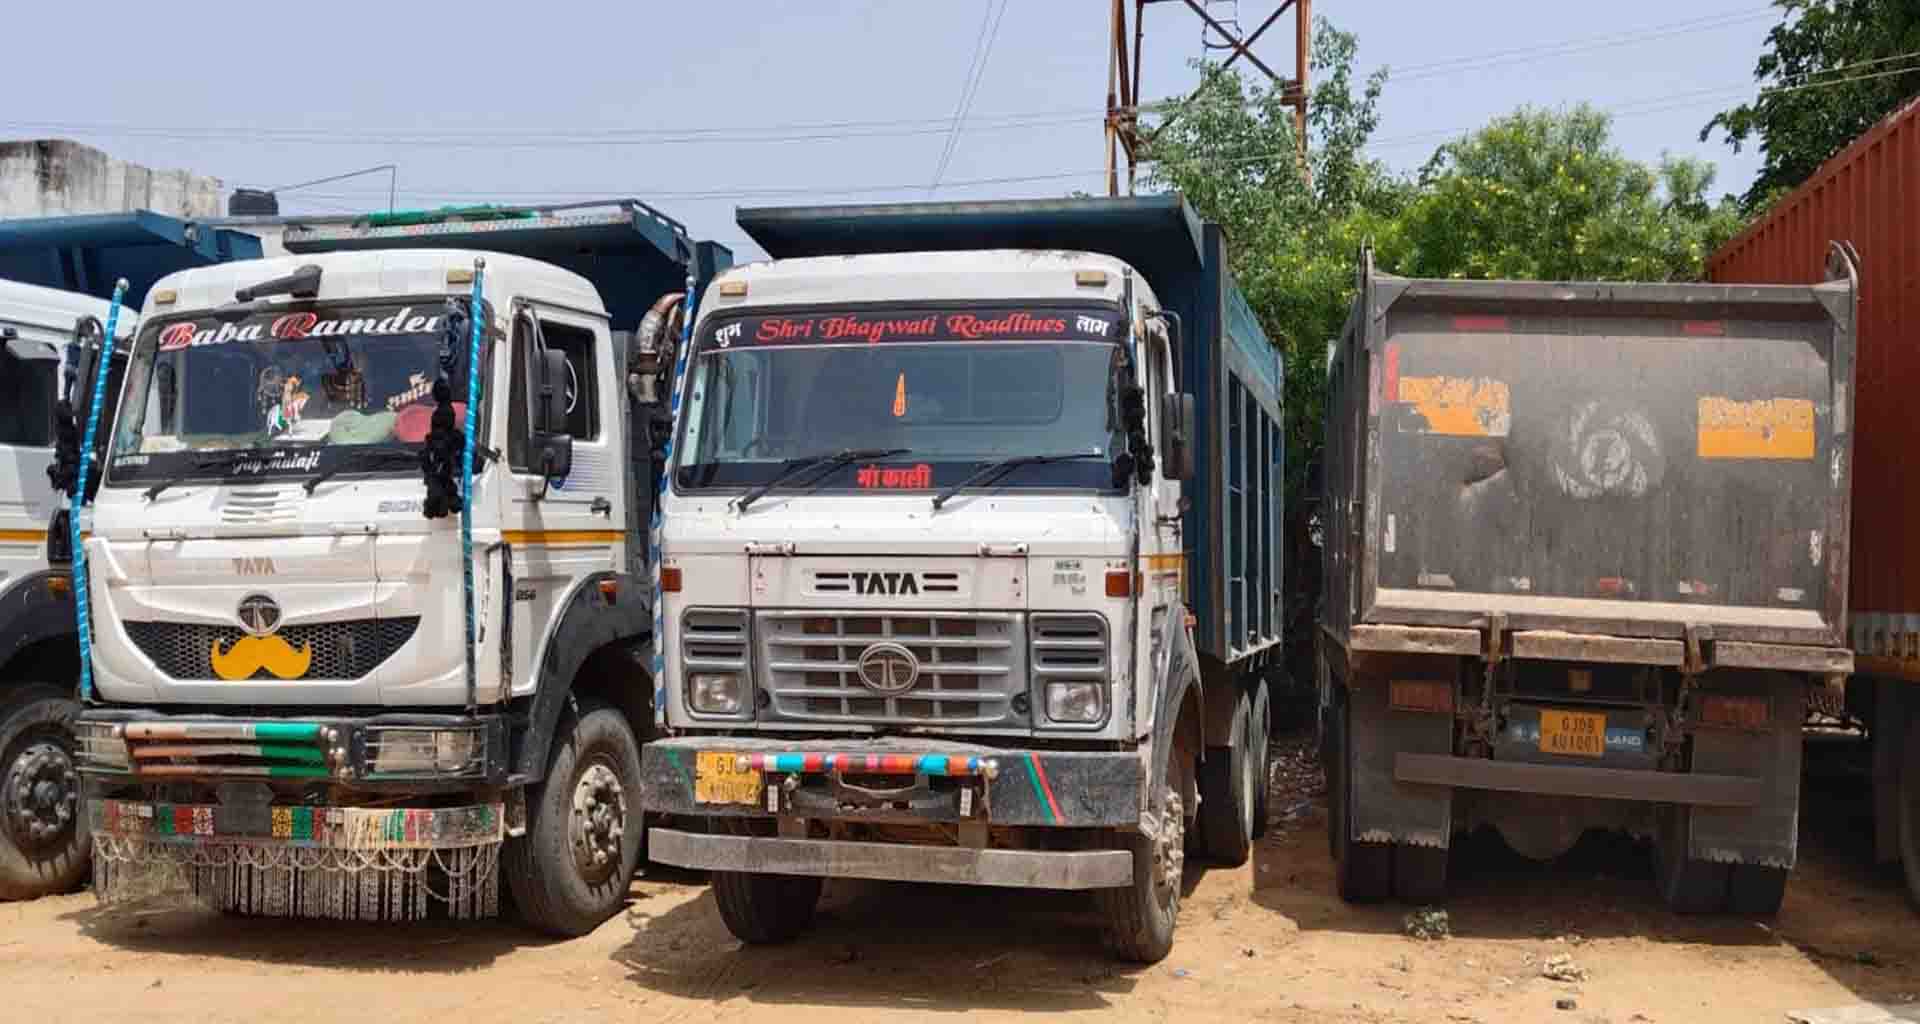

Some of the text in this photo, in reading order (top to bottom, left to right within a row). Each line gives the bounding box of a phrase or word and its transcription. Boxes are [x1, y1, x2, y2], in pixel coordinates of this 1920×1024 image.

[158, 321, 263, 350] Baba
[755, 312, 1066, 345] Shri Bhagwati Roadlines
[231, 556, 277, 575] TATA
[851, 572, 918, 595] TATA
